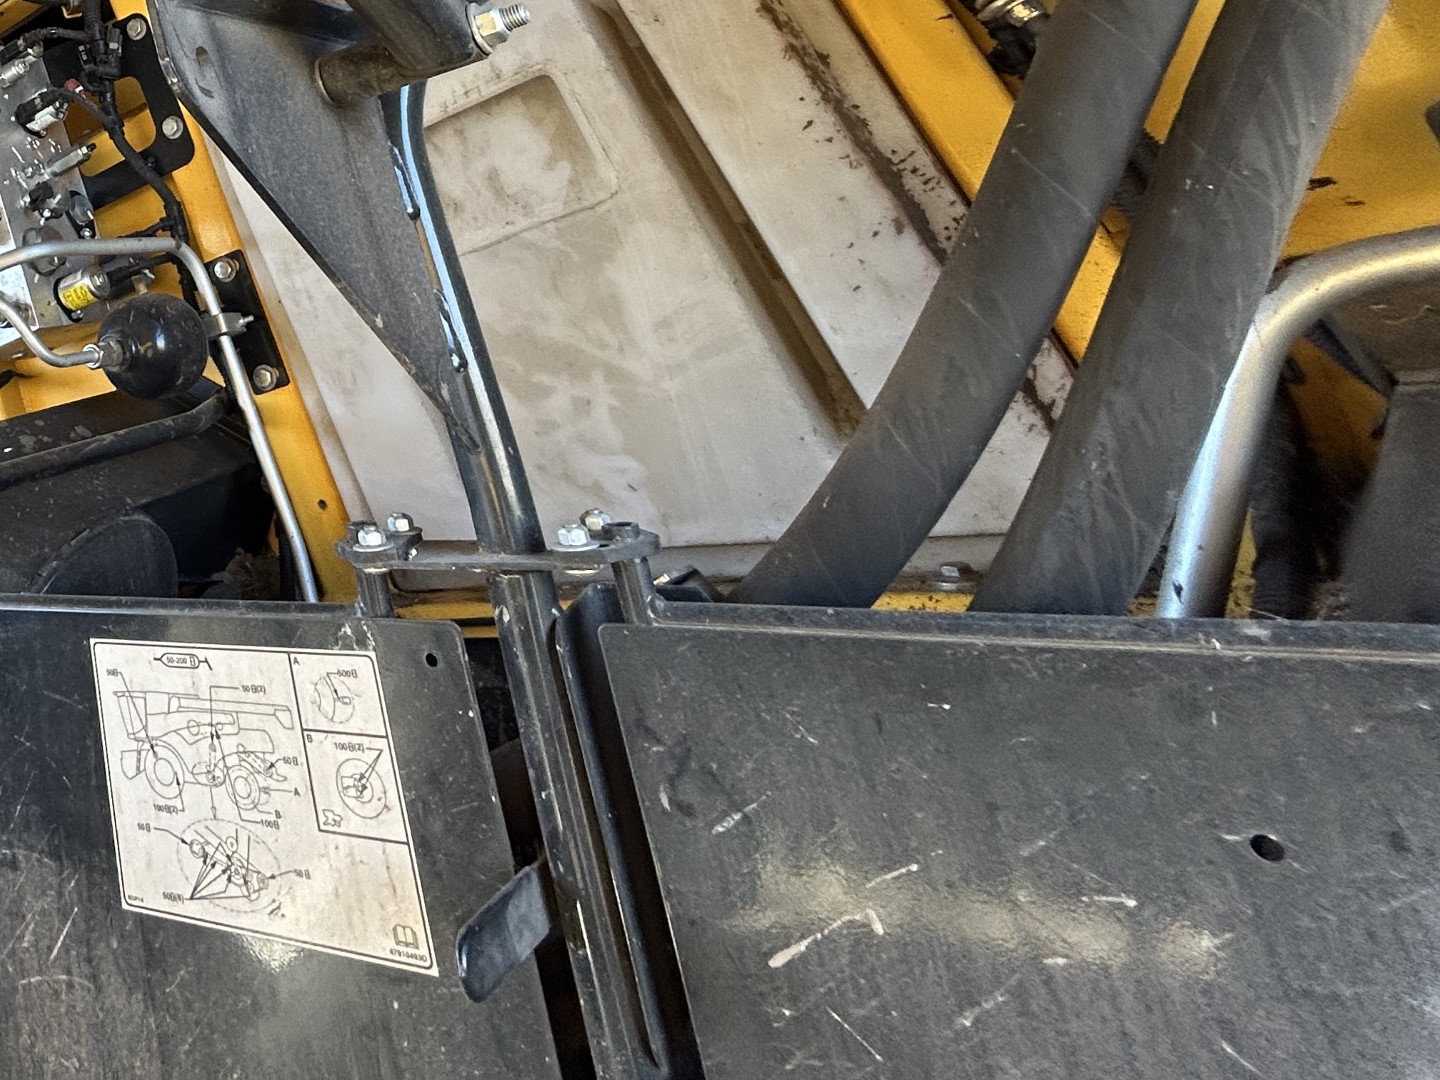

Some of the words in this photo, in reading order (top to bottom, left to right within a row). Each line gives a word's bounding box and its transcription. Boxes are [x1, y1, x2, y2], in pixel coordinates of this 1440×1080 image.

[293, 656, 301, 666] A
[306, 733, 313, 744] B
[293, 787, 301, 797] A
[274, 809, 282, 820] B
